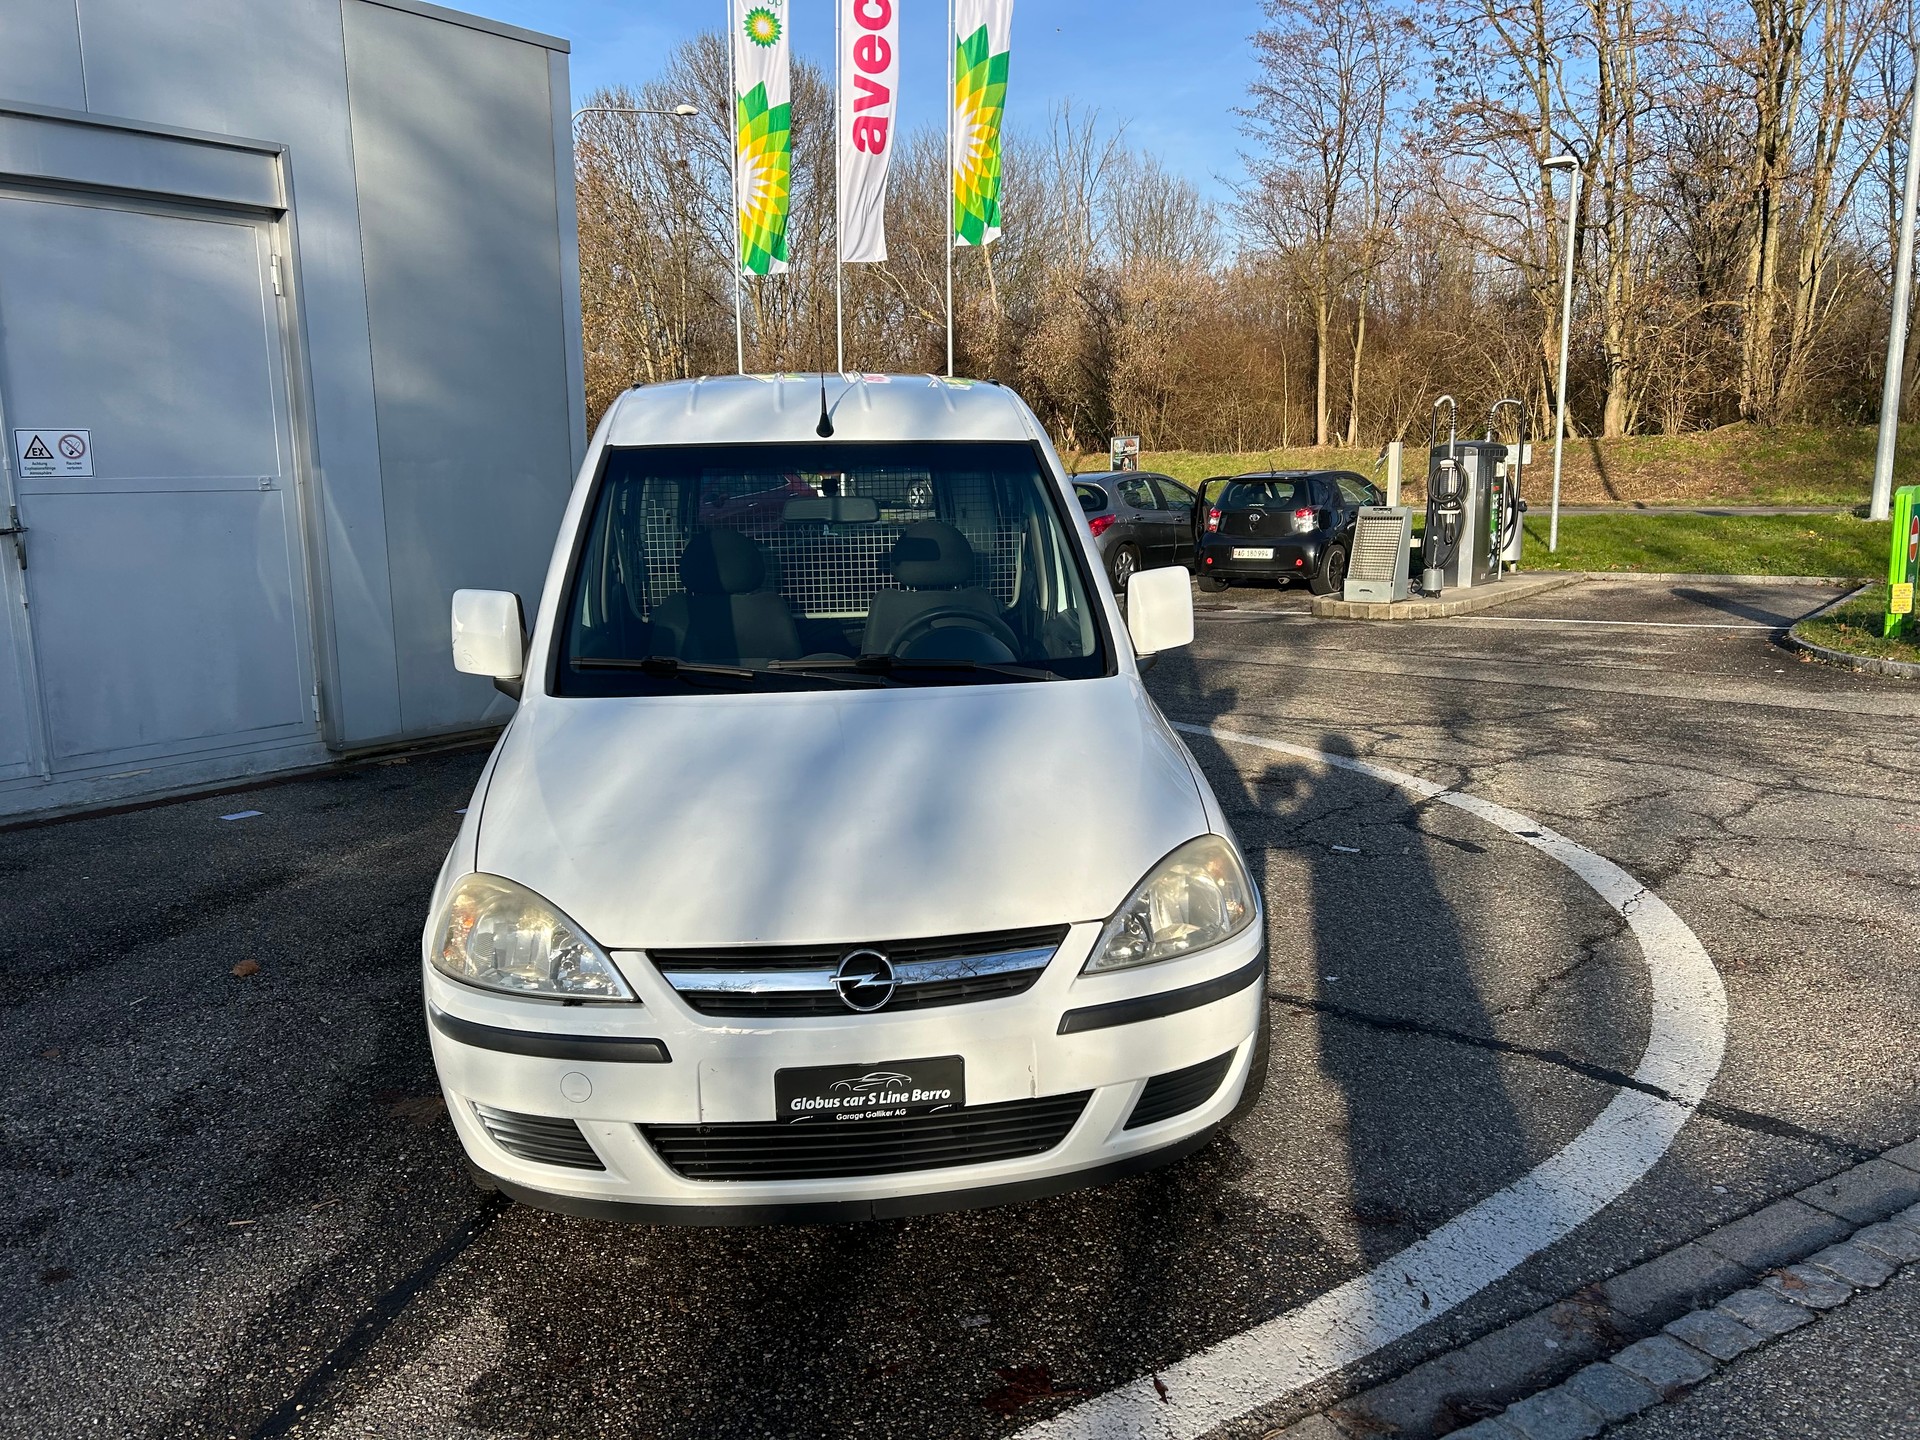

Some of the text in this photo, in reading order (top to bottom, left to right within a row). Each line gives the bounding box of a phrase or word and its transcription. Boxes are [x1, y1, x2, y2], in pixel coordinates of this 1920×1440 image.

[852, 0, 892, 155] avec
[32, 448, 44, 456] EX
[790, 1088, 951, 1111] Globus car S Line Berro
[836, 1112, 864, 1121] Garage
[894, 1108, 907, 1117] AG
